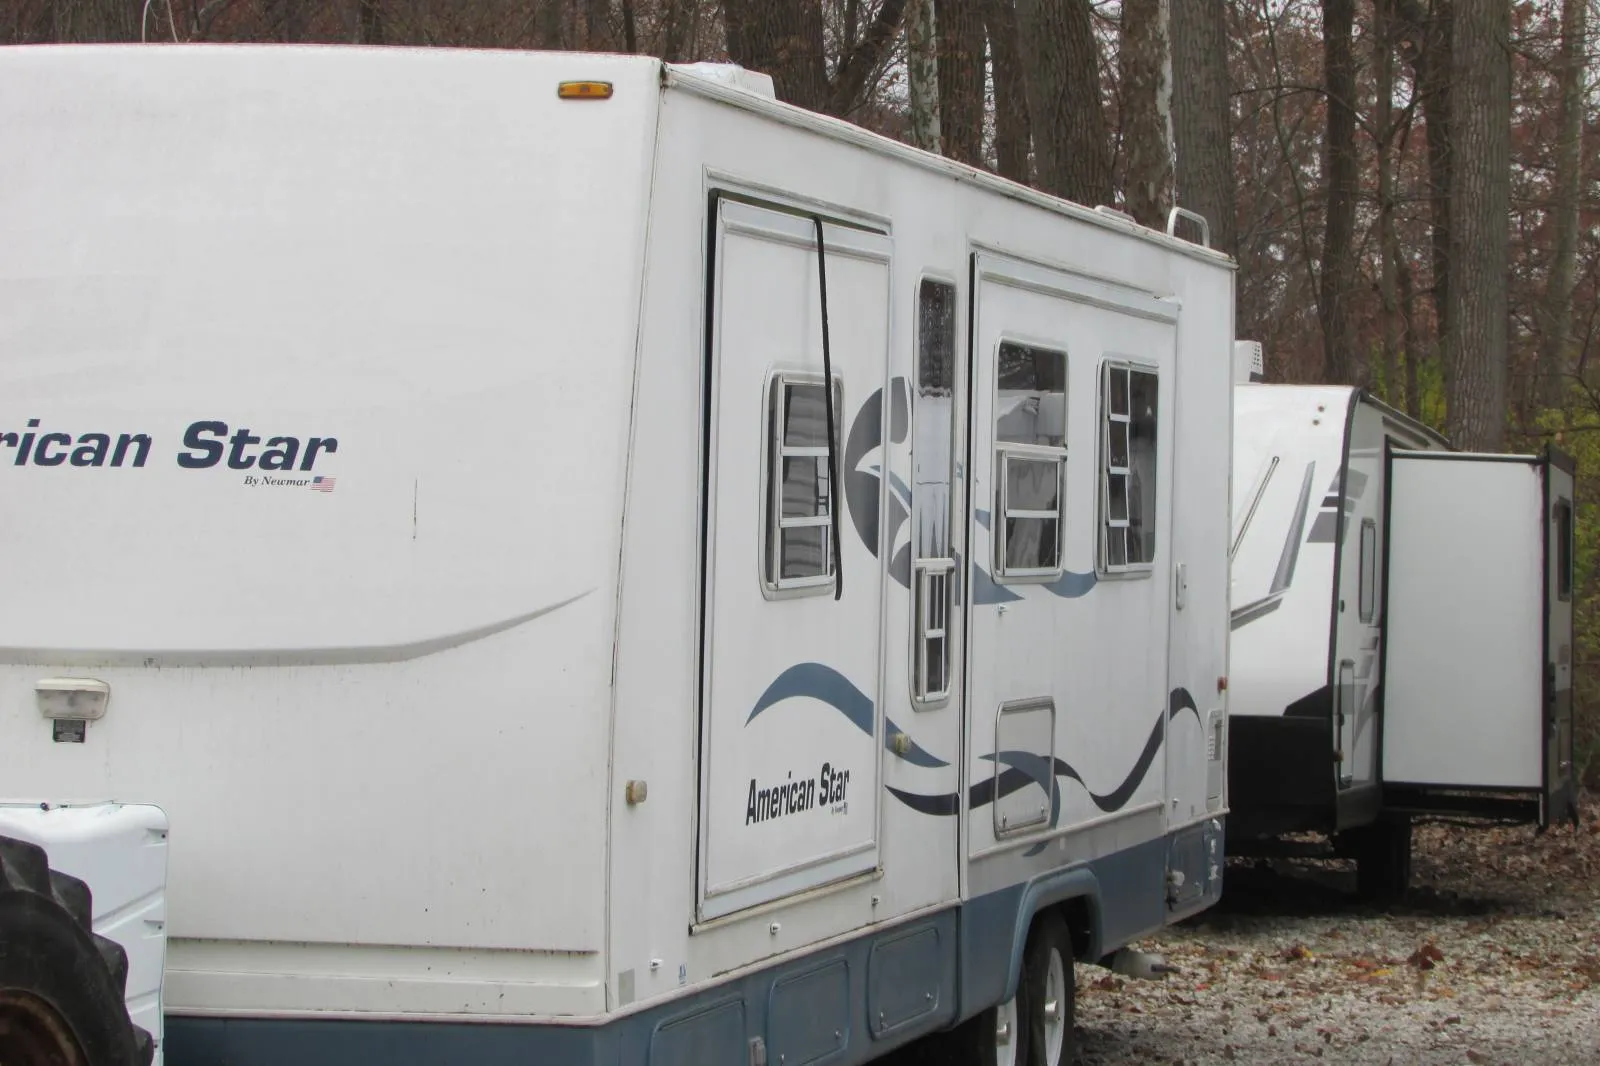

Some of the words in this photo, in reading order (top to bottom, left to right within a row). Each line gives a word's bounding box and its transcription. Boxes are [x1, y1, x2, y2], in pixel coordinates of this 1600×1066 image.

[177, 420, 338, 471] Star
[244, 475, 259, 487] By
[261, 475, 310, 486] Newmar
[745, 769, 815, 826] American
[818, 762, 849, 806] Star
